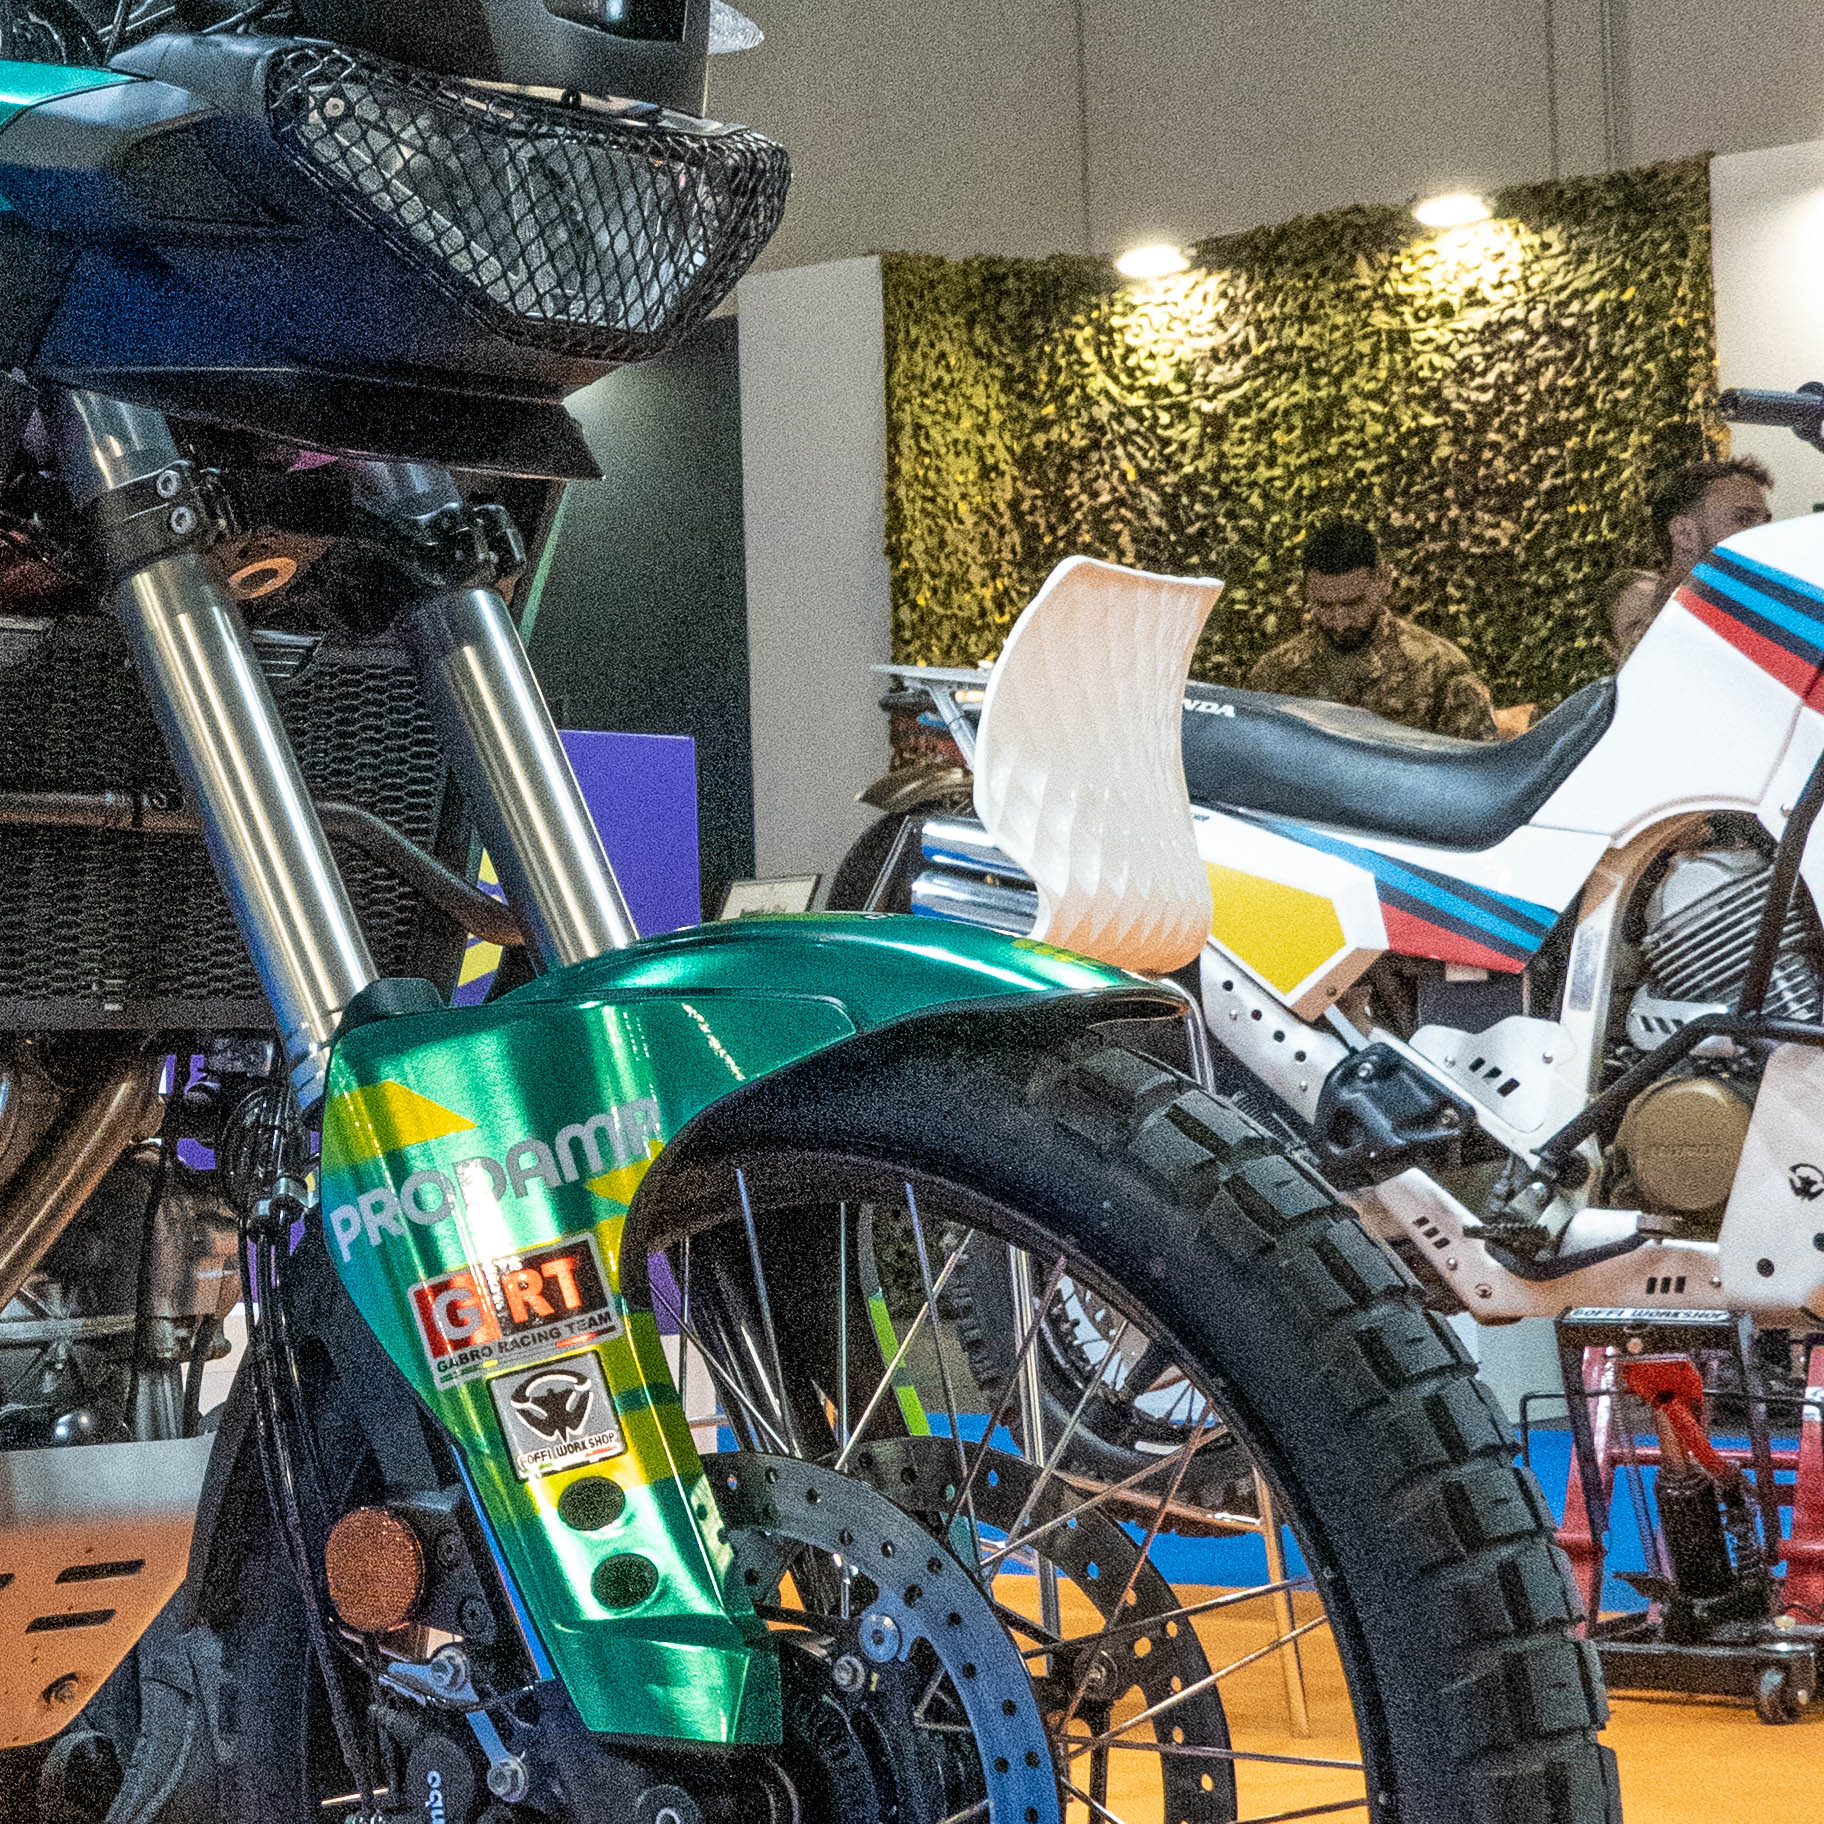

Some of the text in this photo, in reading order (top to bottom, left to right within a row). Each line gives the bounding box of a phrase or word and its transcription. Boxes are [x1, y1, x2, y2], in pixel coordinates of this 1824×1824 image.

[436, 1311, 613, 1374] GABRO RACING TEAM
